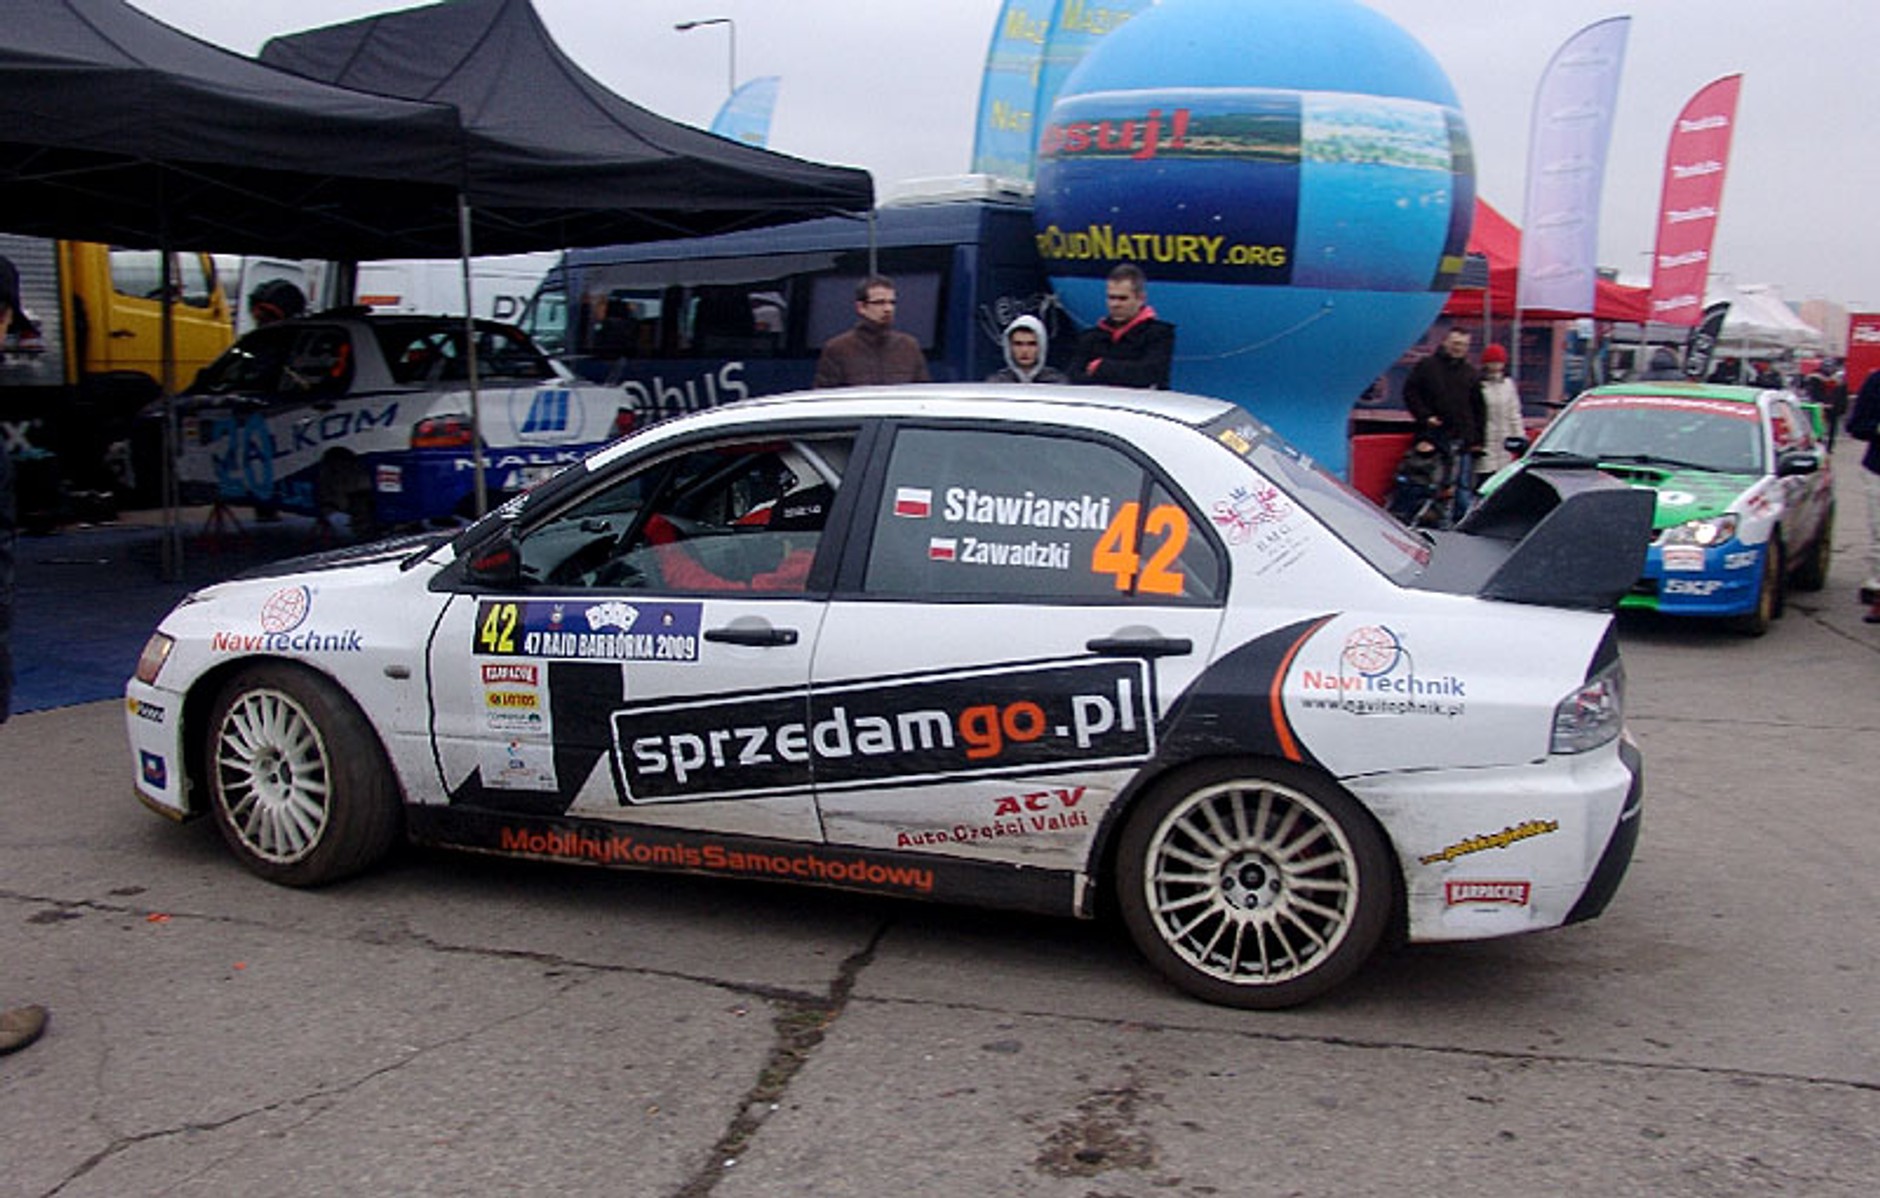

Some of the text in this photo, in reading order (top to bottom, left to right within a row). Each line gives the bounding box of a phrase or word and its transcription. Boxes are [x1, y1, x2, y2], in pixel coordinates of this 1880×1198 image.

[944, 487, 1110, 530] Stawiarski
[960, 537, 1071, 569] Zawadzki
[1091, 501, 1191, 595] 42
[212, 629, 363, 652] NaviTechnik
[481, 602, 518, 652] 42
[524, 632, 541, 654] 47
[543, 632, 577, 656] RAJD
[656, 635, 695, 659] 2009
[1303, 669, 1466, 696] NaviTechnik
[632, 679, 1136, 784] sprzedamgo.pl
[994, 786, 1087, 816] ACV
[897, 831, 948, 848] Auto
[1031, 811, 1089, 831] Valdi
[501, 827, 935, 892] MobilnyKomisSamochodowy
